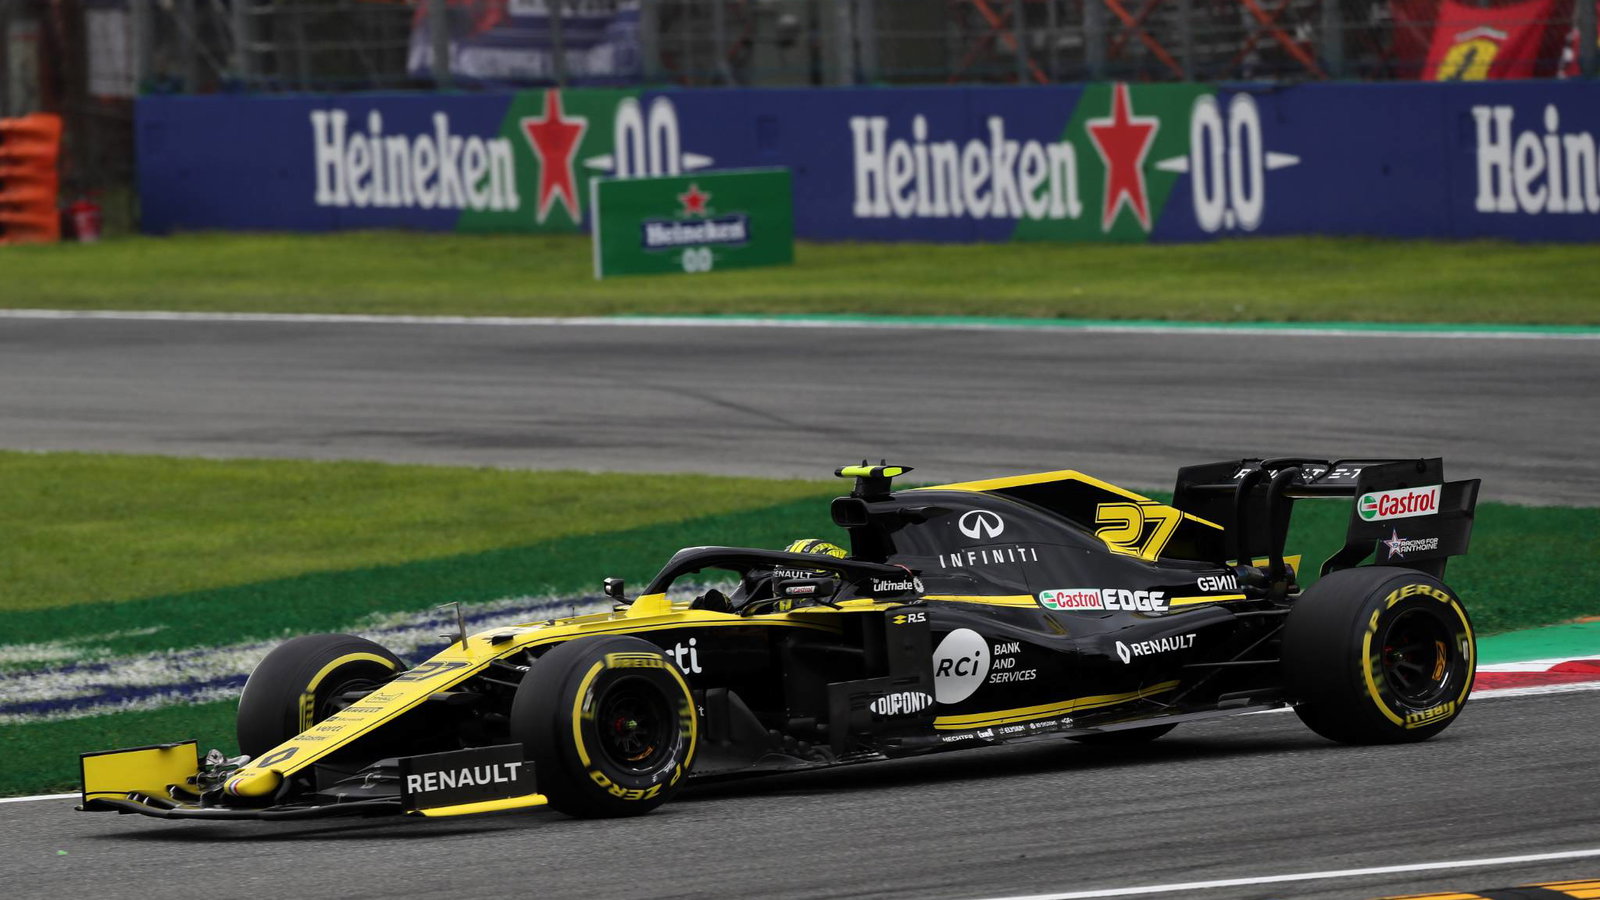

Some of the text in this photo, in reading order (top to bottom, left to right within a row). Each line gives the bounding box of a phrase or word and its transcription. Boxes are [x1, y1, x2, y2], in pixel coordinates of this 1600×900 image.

[311, 108, 520, 211] Heineken
[850, 92, 1265, 232] Heineken 0.0
[1471, 103, 1600, 215] Hein
[1378, 489, 1436, 517] Castrol
[1095, 502, 1183, 562] 27
[938, 547, 1038, 569] INFINITI
[873, 579, 913, 592] ultimate
[1056, 588, 1169, 612] Castrol EDGE
[994, 641, 1021, 656] BANK
[1131, 633, 1197, 657] RENAULT
[992, 658, 1016, 670] AND
[989, 669, 1037, 684] SERVICES
[877, 691, 928, 716] DUPONT
[406, 761, 522, 794] RENAULT
